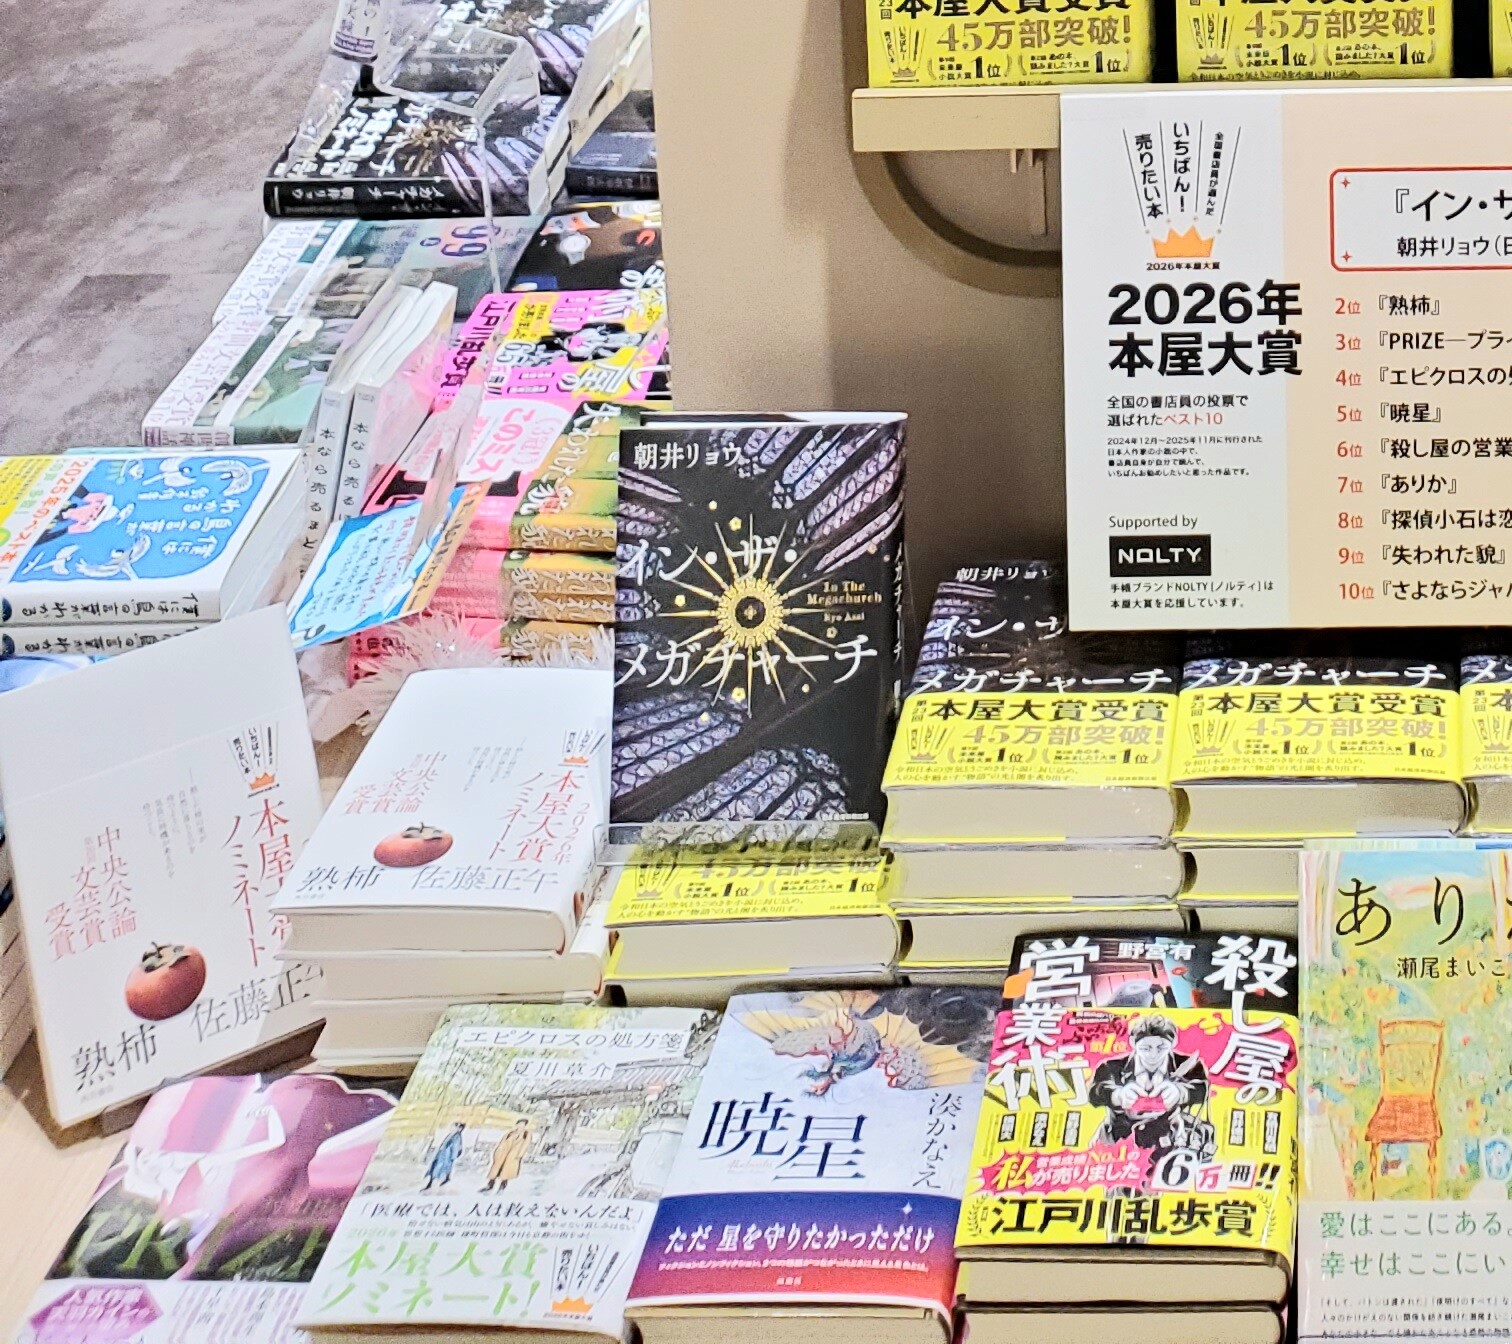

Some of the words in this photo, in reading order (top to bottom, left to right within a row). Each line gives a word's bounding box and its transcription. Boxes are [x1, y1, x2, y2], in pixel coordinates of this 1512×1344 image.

[1134, 133, 1164, 219] 売りたい本
[1174, 122, 1191, 212] いちばん!
[1147, 262, 1220, 271] 2026年本屋大賞
[1108, 279, 1302, 326] 2026年
[1335, 299, 1361, 315] 2位
[1378, 295, 1440, 315] 『熟柿』
[1109, 329, 1303, 377] 本屋大賞
[1336, 335, 1361, 350] 3位
[1336, 370, 1361, 386] 4位
[1107, 395, 1249, 409] 全国の書店員の投票で
[1337, 406, 1362, 422] 5位
[1380, 403, 1441, 423] 『暁星』
[1107, 412, 1223, 427] 選ばれたベスト10
[634, 441, 742, 470] 朝井リョウ
[1337, 442, 1363, 458] 6位
[1338, 477, 1363, 493] 7位
[1381, 474, 1457, 494] 『ありか』
[1109, 516, 1178, 530] Supported
[1182, 516, 1198, 530] by
[1338, 513, 1363, 529] 8位
[1118, 548, 1201, 564] NOLTY
[1339, 548, 1364, 564] 9位
[1382, 545, 1505, 565] 『失われた貌』
[1340, 584, 1374, 600] 10位
[615, 635, 878, 687] メガチャーチ
[1190, 661, 1446, 688] メガチャーチ
[488, 772, 543, 859] ノミネート
[511, 770, 585, 863] 本屋大賞
[554, 802, 591, 865] 2026年
[97, 826, 137, 938] 中央公論
[222, 815, 265, 967] ノミネート
[296, 866, 388, 893] 熟柿
[411, 865, 559, 894] 佐藤正午
[1119, 943, 1196, 959] 野宮有
[1397, 955, 1507, 979] 瀬尾まいこ
[991, 936, 1099, 1111] 営業術
[1204, 936, 1297, 1105] 殺し屋の
[464, 1030, 684, 1055] エピクロスの処方箋
[72, 1023, 156, 1093] 熟柿
[509, 1061, 613, 1079] 夏川草介
[698, 1091, 868, 1182] 暁星
[913, 1093, 962, 1189] 湊かなえ
[991, 1197, 1256, 1238] 江戸川乱歩賞
[664, 1224, 712, 1254] ただ
[716, 1223, 935, 1254] 星を守りたかっただけ
[338, 1241, 548, 1278] 本屋大賞
